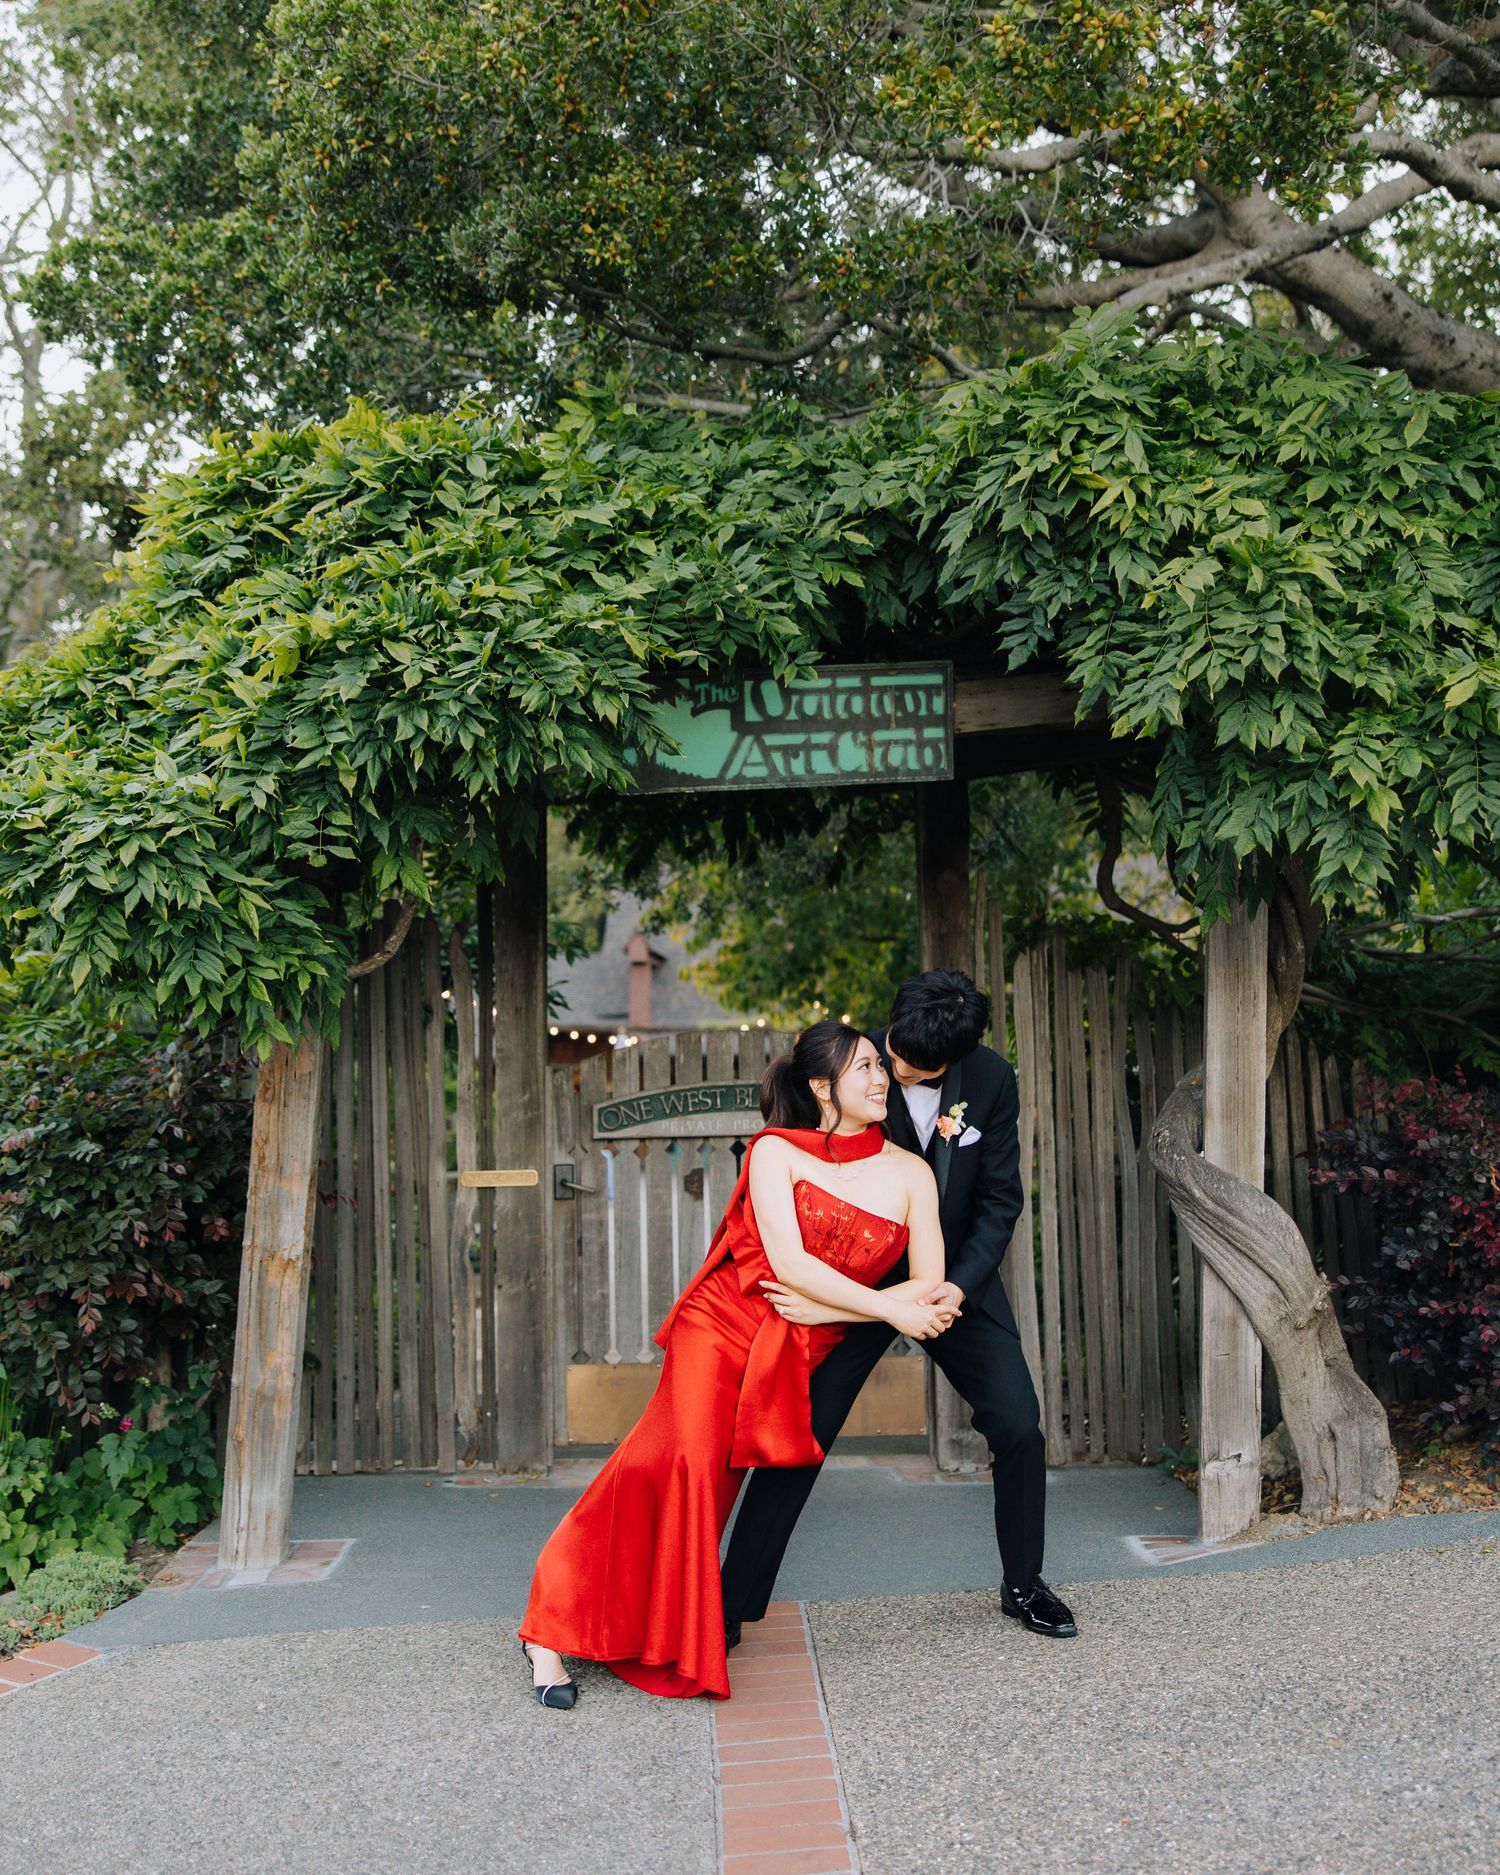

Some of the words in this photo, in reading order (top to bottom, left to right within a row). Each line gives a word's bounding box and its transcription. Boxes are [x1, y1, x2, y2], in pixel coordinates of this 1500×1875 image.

[694, 682, 740, 707] The
[752, 674, 943, 722] Outdoor
[732, 734, 829, 779] Art
[827, 727, 942, 774] Club
[601, 1099, 654, 1129] ONE
[659, 1088, 726, 1114] WEST
[736, 1087, 760, 1108] BL
[661, 1119, 722, 1132] PRIVATE
[734, 1118, 765, 1131] PRO
